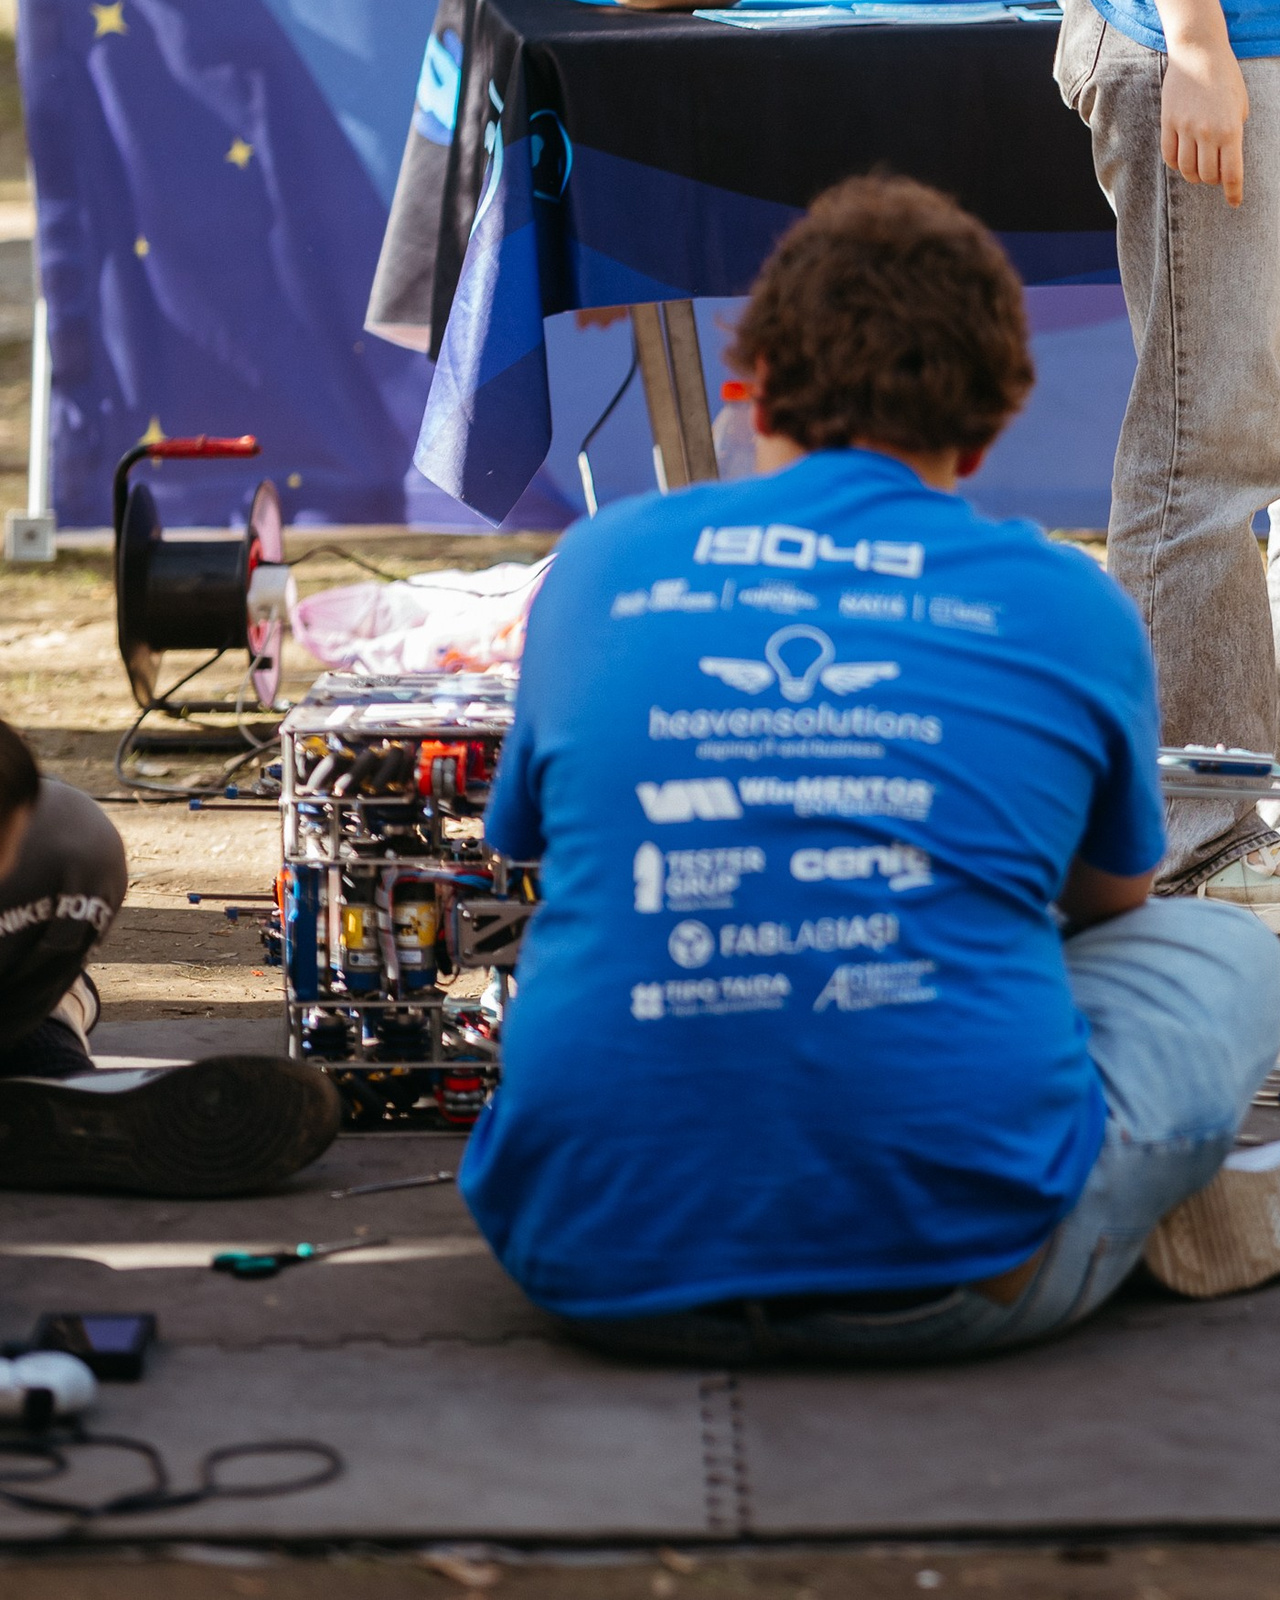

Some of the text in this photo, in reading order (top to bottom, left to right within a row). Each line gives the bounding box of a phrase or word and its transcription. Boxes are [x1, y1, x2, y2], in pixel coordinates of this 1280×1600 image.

[693, 524, 925, 579] 19043
[648, 701, 943, 744] heavensolutions
[666, 846, 766, 874] TESTER
